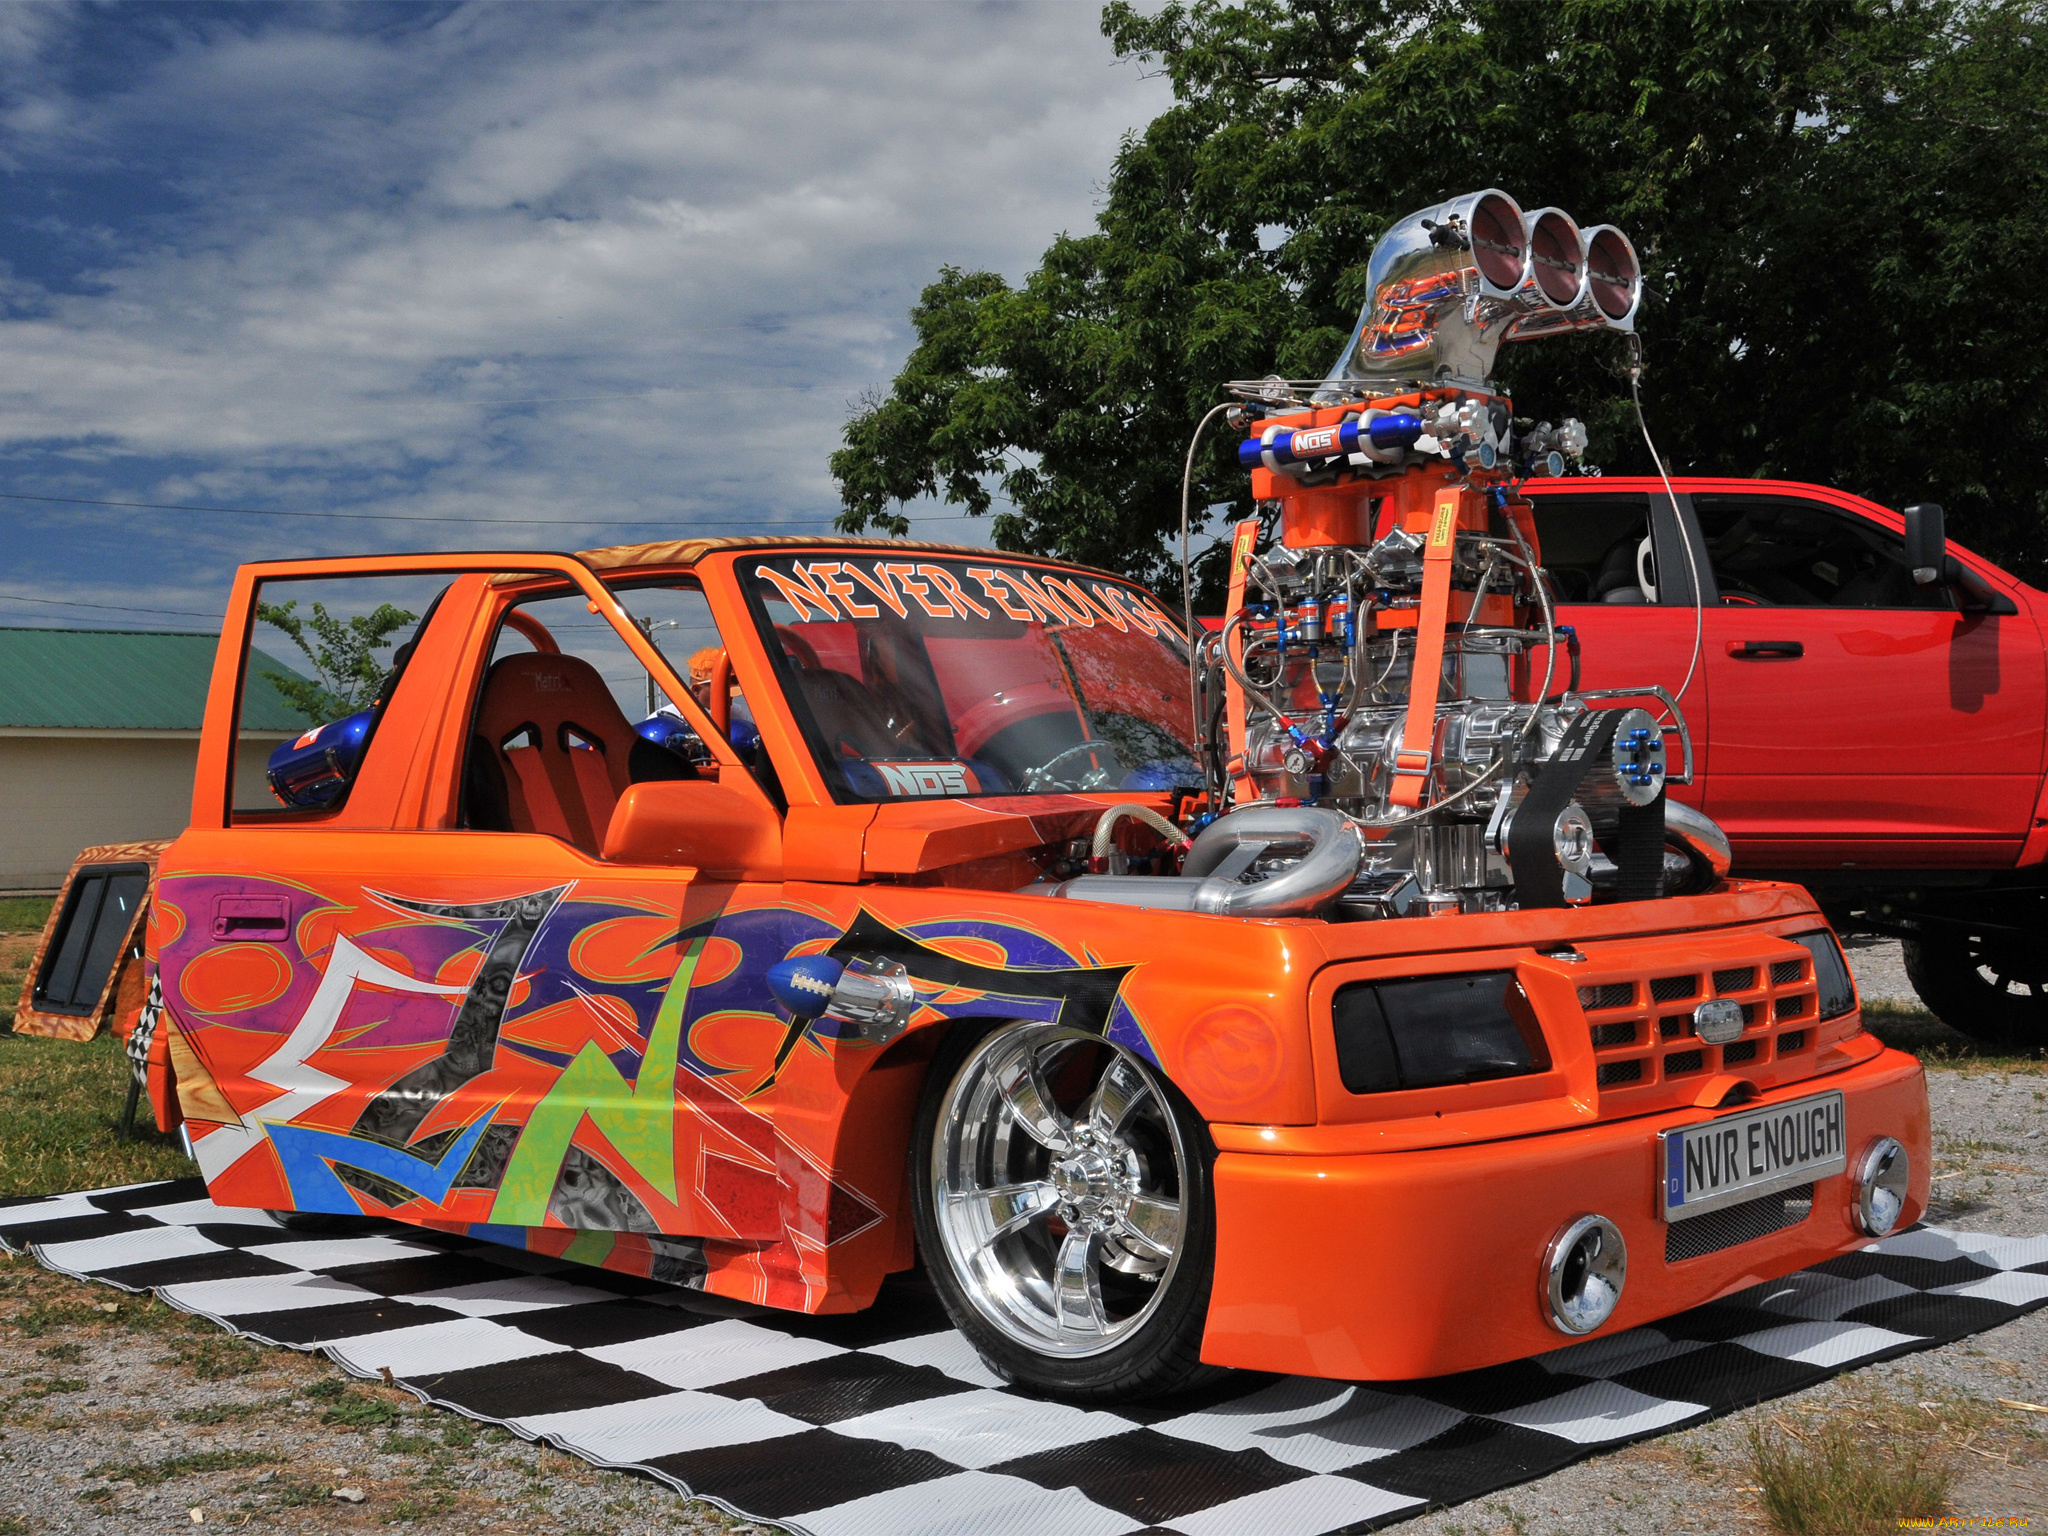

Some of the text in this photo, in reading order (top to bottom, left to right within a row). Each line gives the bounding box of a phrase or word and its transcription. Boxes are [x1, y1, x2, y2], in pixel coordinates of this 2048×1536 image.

[1295, 428, 1336, 452] NOS
[755, 559, 1190, 645] NEVER ENOUGH
[877, 763, 967, 796] NOS
[1671, 1102, 1840, 1193] D NVR ENOUGH
